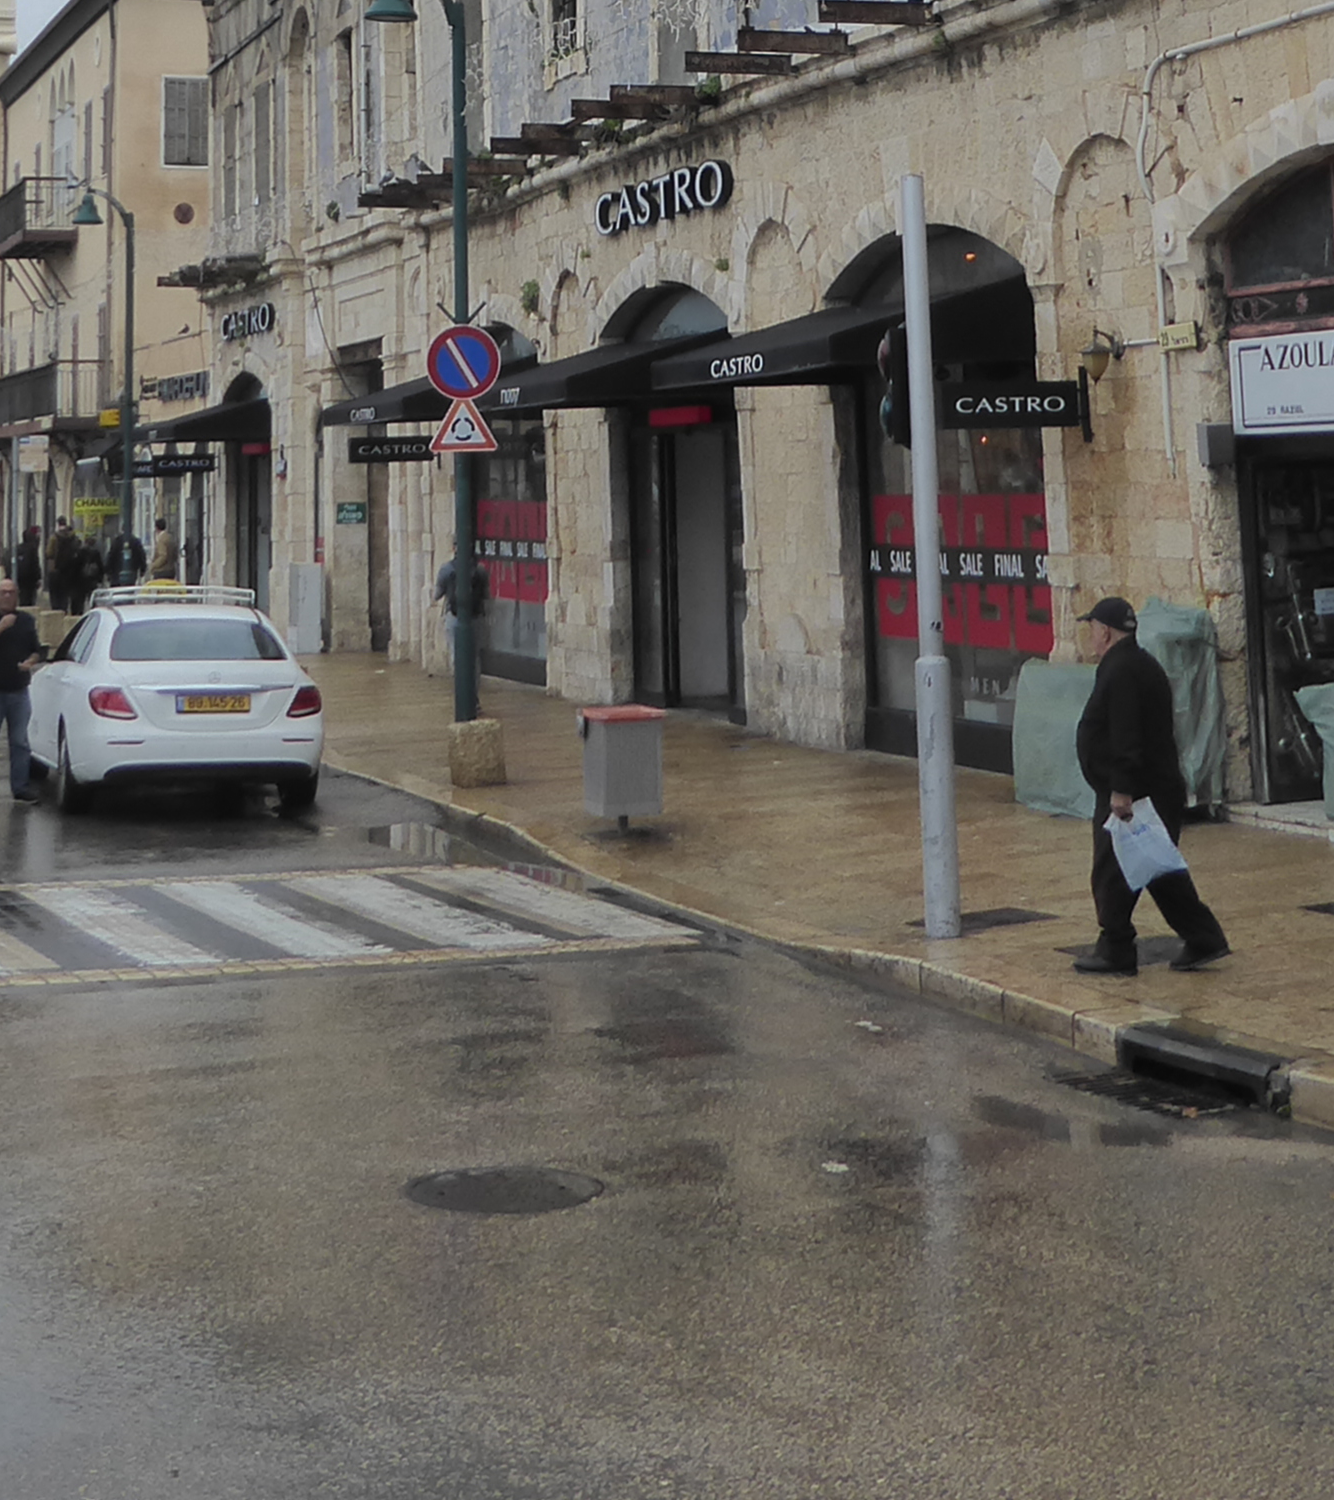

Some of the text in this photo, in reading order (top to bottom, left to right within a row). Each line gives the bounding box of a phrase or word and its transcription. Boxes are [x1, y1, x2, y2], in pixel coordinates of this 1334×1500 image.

[594, 159, 734, 236] CASTRO
[710, 353, 764, 379] CASTRO
[955, 396, 1066, 414] CASTRO
[350, 407, 375, 423] CASTRO
[358, 443, 426, 456] CASTRO
[158, 458, 210, 469] CASTRO
[75, 498, 118, 508] CHANGE
[890, 550, 912, 572] SALE
[959, 553, 984, 576] SALE
[994, 554, 1025, 578] FINAL
[1035, 555, 1047, 579] SA
